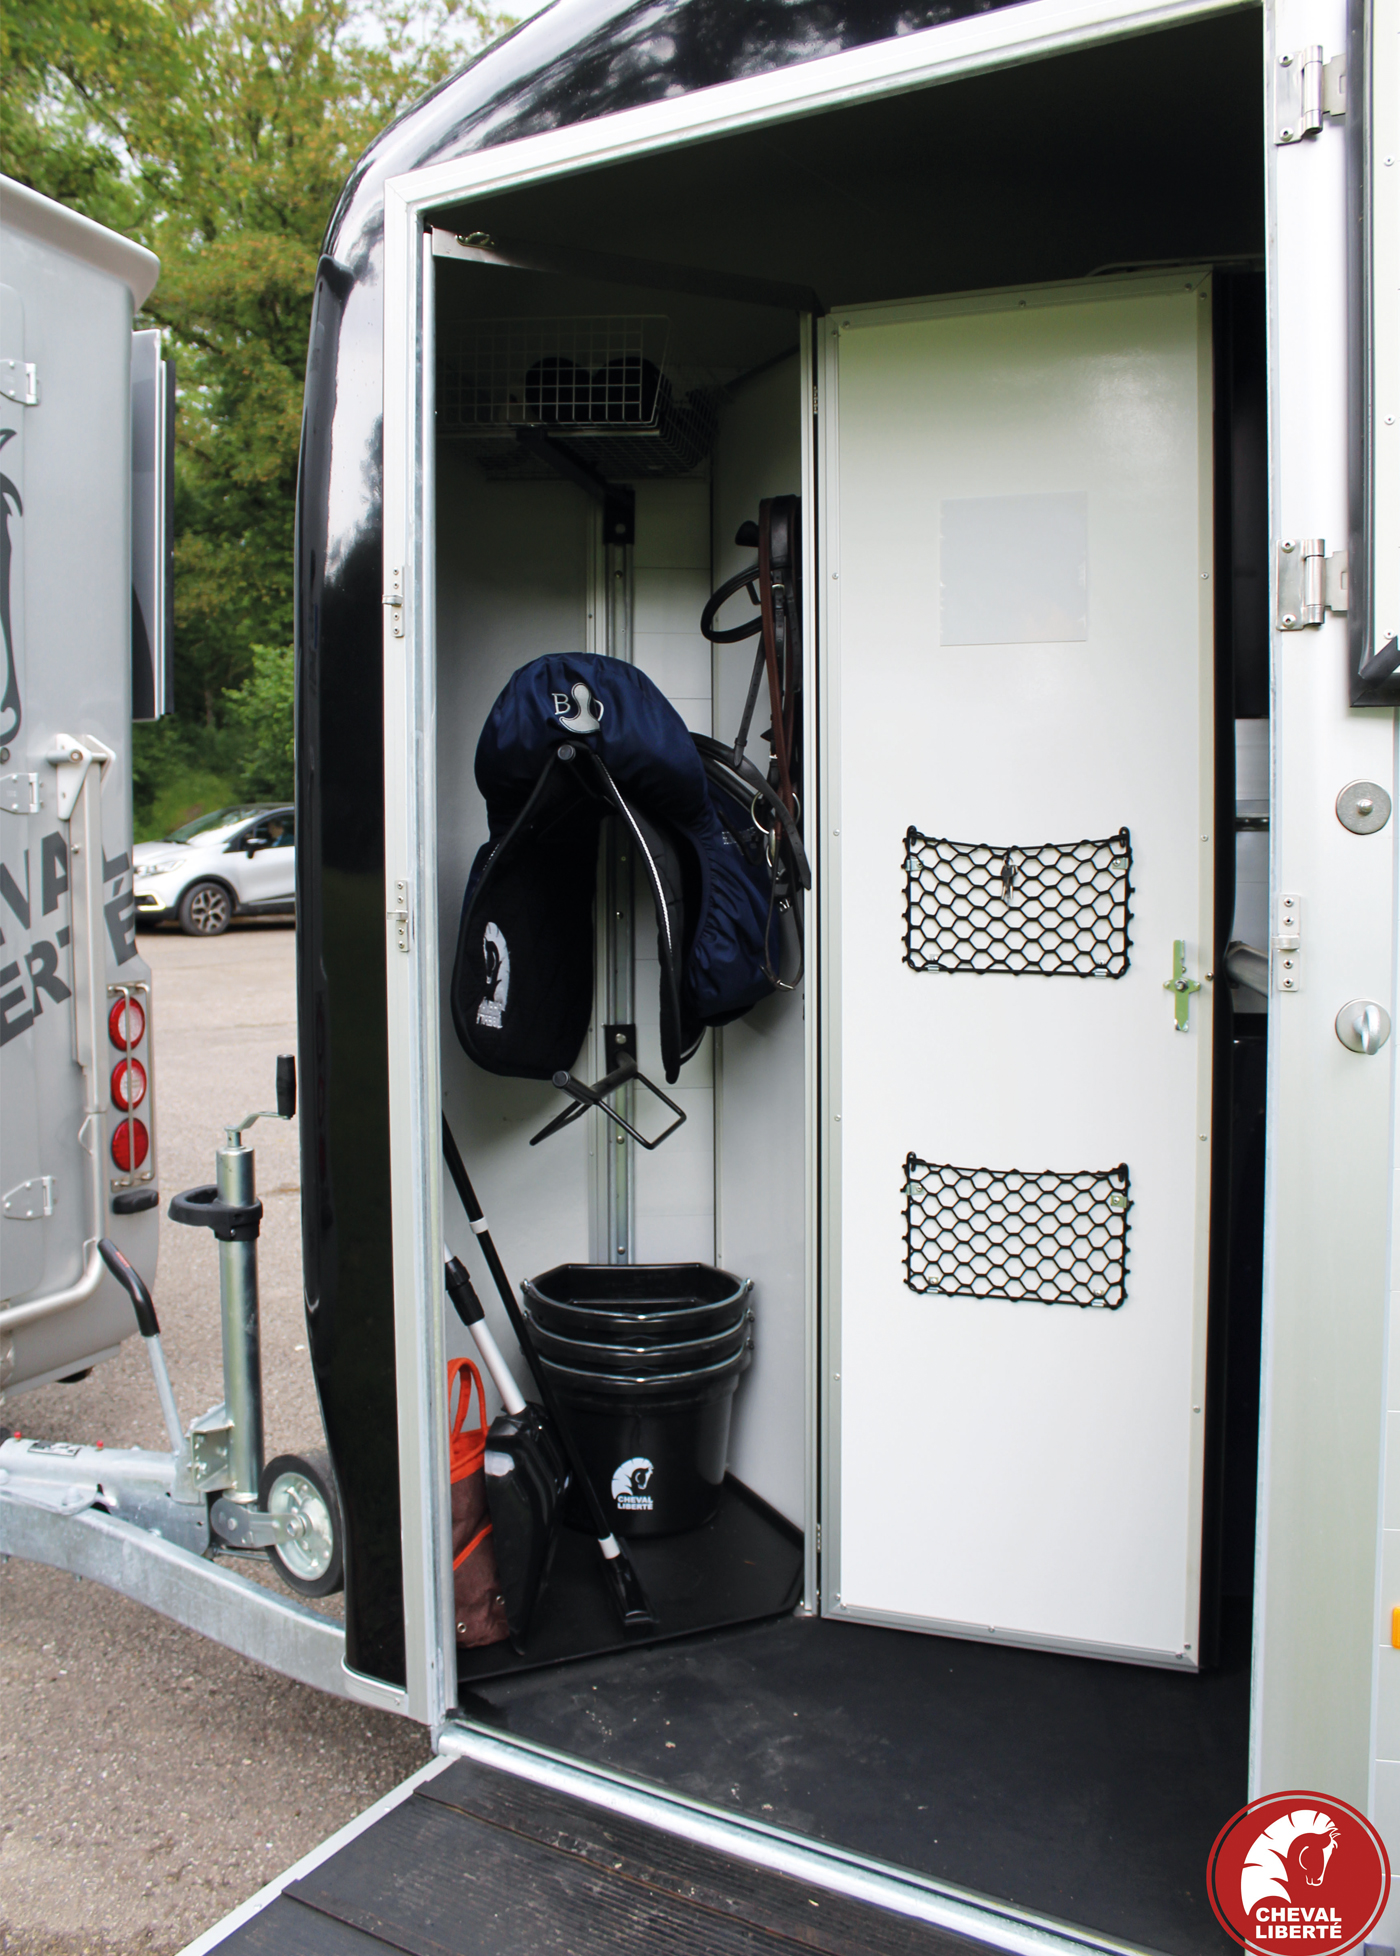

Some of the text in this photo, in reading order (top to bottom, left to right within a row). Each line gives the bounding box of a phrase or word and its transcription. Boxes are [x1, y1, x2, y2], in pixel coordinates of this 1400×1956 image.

[0, 830, 130, 946] VAL
[0, 877, 138, 1047] ERÉ
[617, 1495, 654, 1504] CHEVAL
